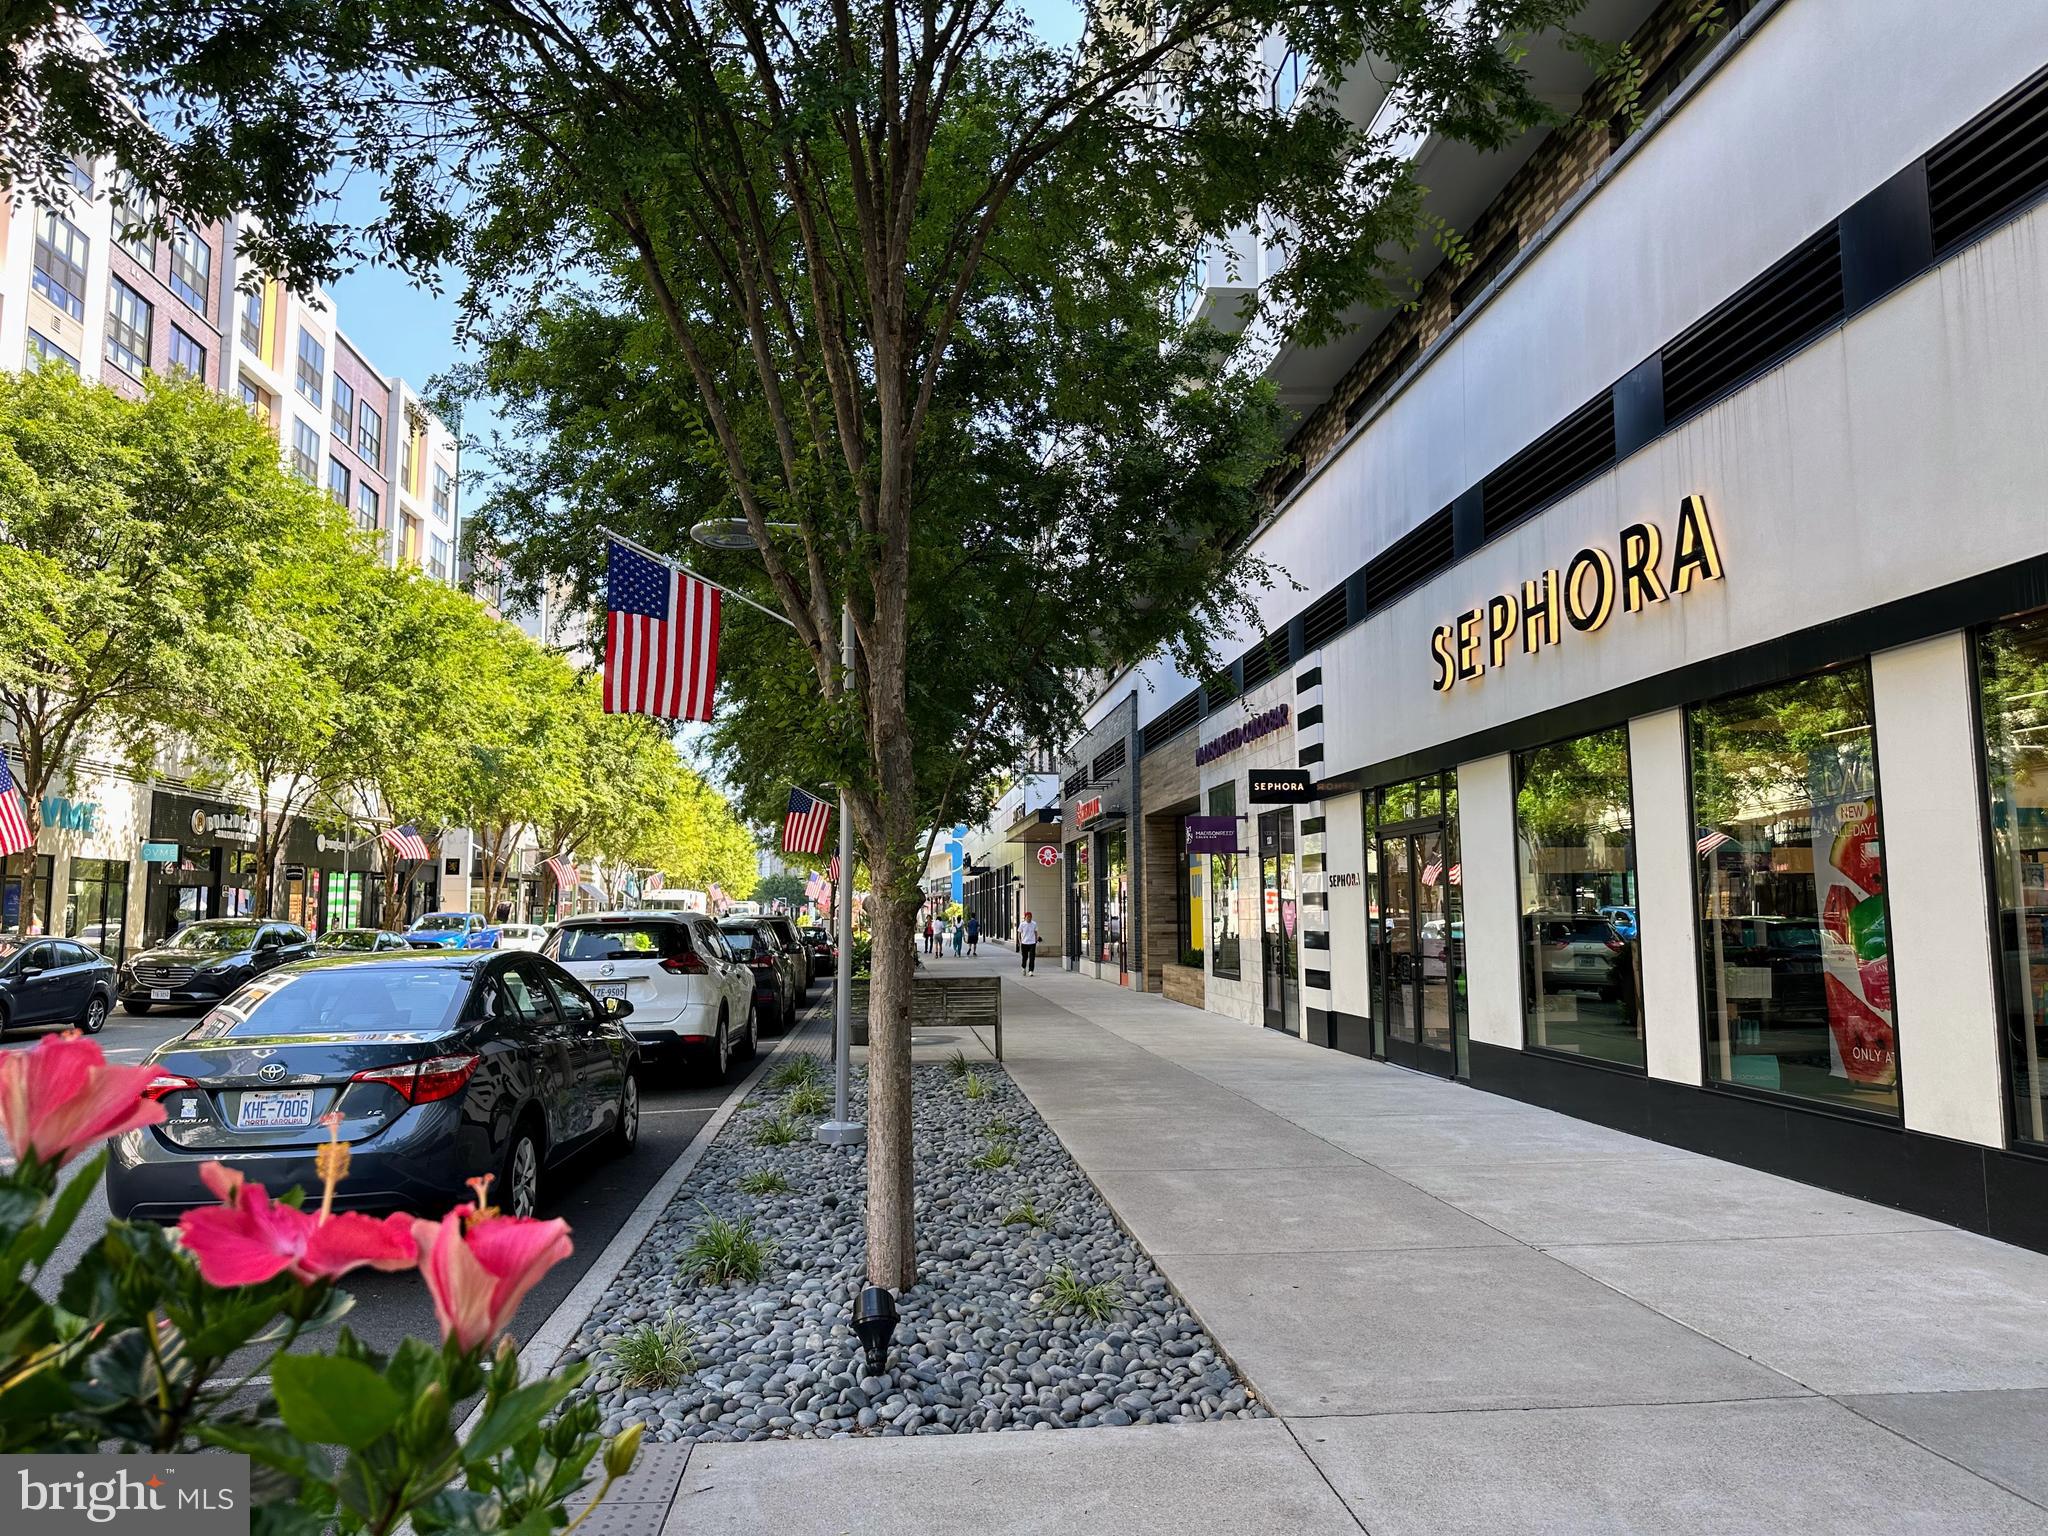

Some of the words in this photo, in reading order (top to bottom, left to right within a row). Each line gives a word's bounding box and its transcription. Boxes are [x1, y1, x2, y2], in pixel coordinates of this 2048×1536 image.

[1431, 495, 1724, 691] SEPHORA
[1254, 782, 1304, 791] SEPHORA
[1840, 805, 1863, 819] NEW
[143, 847, 177, 856] OVME
[1852, 1047, 1881, 1062] ONLY
[243, 1100, 309, 1119] KHE-7806
[245, 1119, 268, 1127] NORTH
[271, 1118, 303, 1126] CAROLINA
